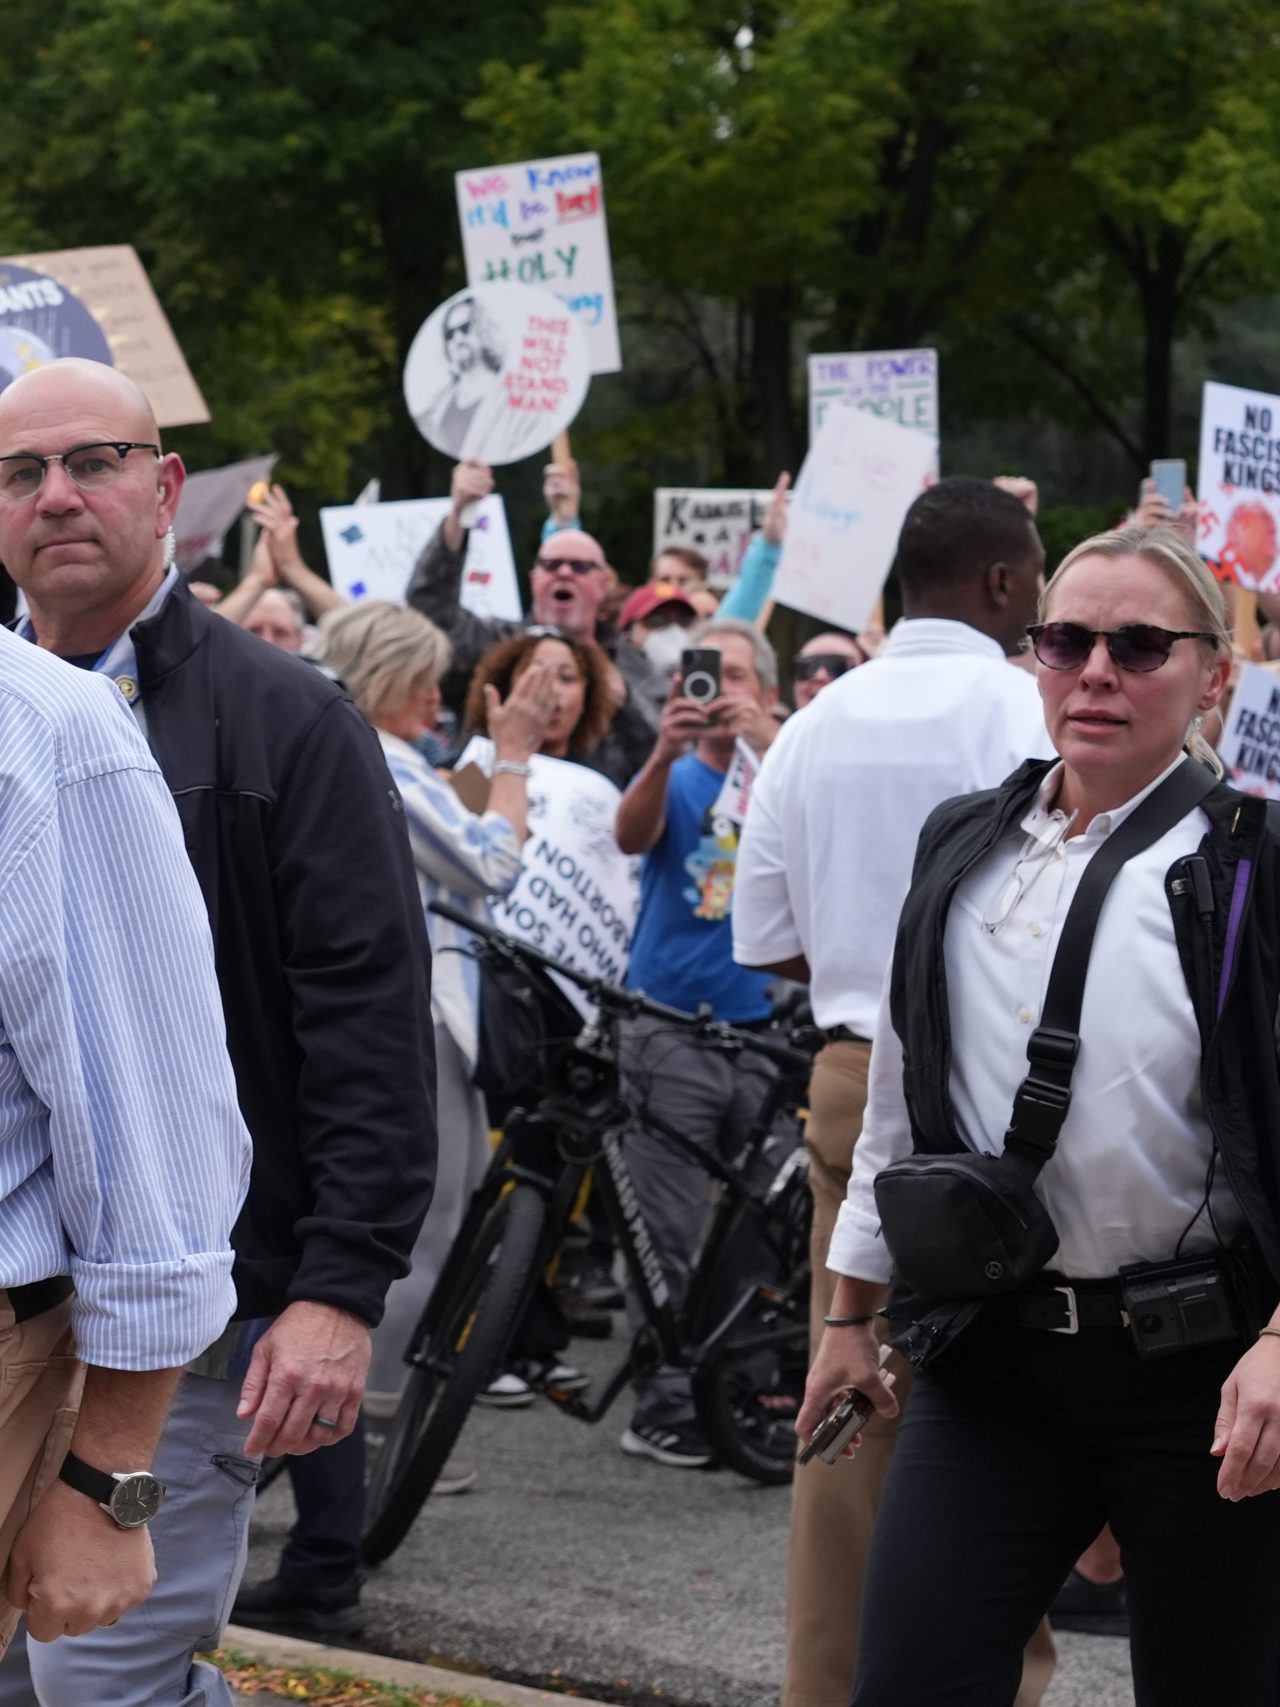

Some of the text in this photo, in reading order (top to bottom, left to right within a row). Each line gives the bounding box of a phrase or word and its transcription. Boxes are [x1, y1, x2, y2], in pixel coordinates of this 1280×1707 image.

[480, 245, 578, 284] HOLY
[521, 356, 561, 372] NOT
[504, 372, 569, 394] STAND
[816, 394, 931, 428] POPLE
[1245, 405, 1272, 433] NO
[528, 876, 580, 929] HAD
